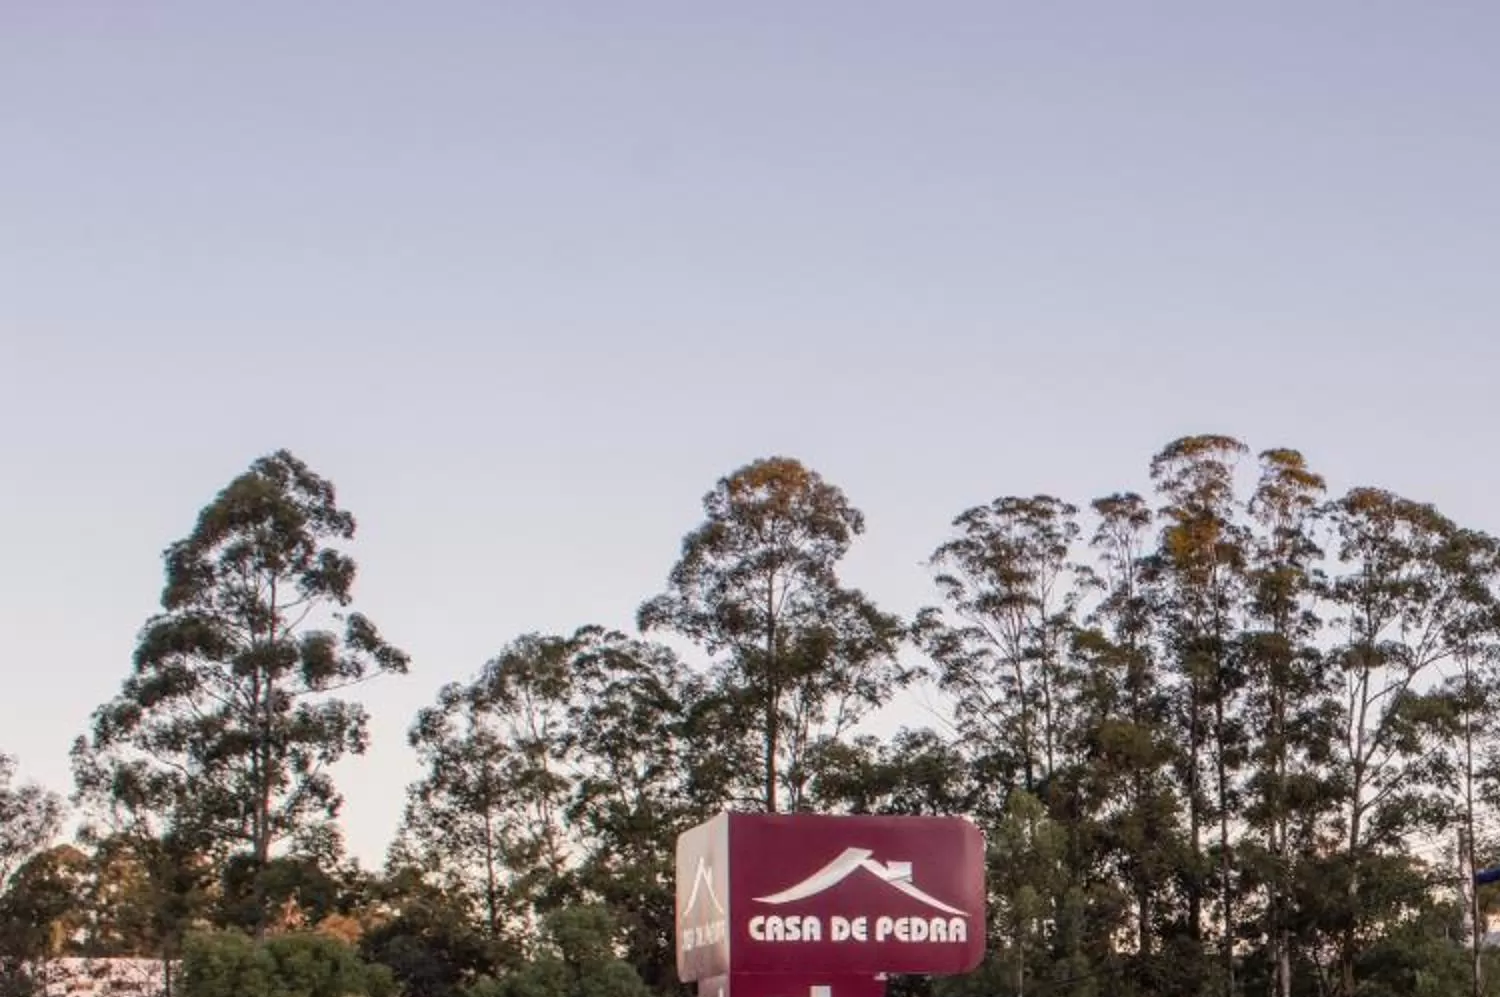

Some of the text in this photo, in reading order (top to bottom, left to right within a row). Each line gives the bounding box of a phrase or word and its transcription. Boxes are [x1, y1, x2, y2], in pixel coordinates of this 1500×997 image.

[749, 915, 821, 941] CASA
[830, 916, 868, 941] DE
[875, 916, 967, 942] PEDRA
